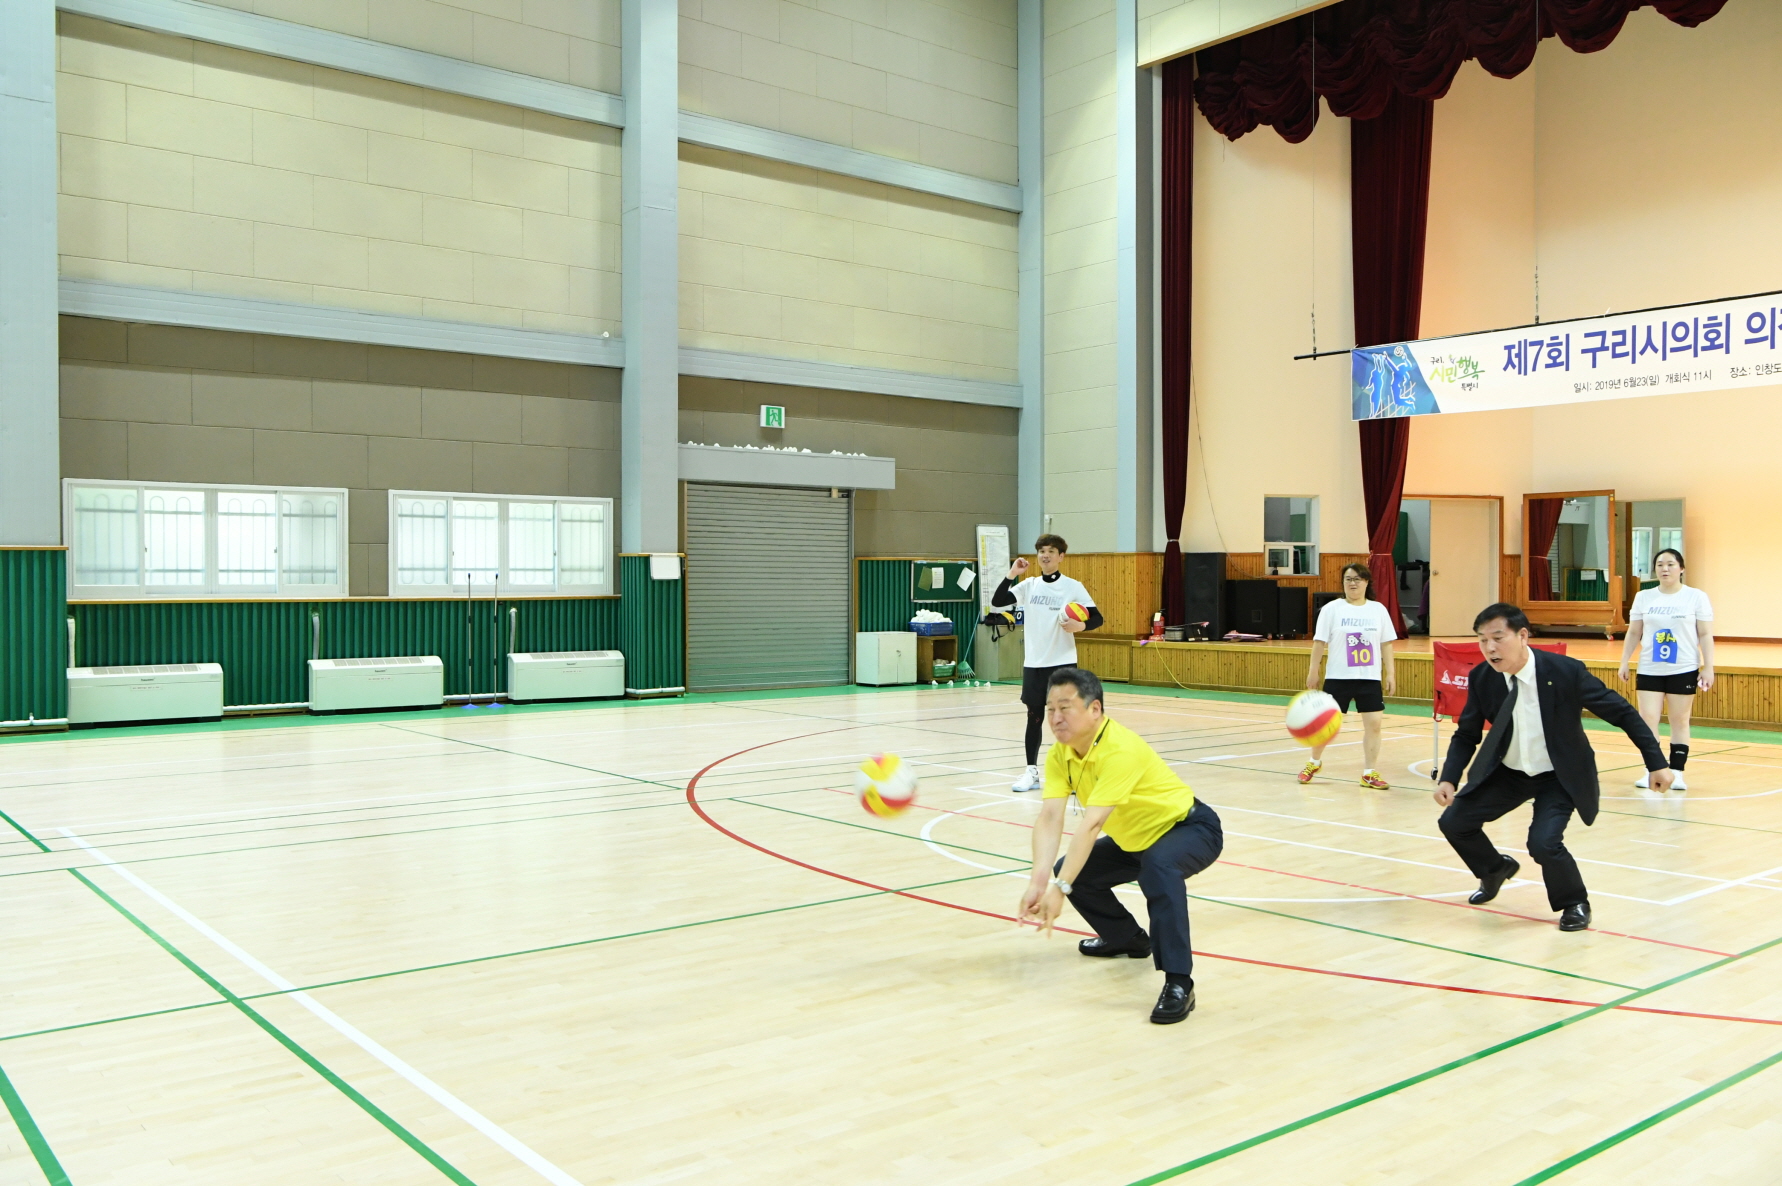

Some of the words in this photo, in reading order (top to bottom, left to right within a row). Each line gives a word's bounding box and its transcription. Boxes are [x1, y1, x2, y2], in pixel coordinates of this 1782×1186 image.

[1502, 333, 1570, 376] 제7회
[1581, 313, 1731, 369] 구리시의회
[1744, 307, 1782, 350] 의
[1573, 381, 1592, 393] 일시:
[1595, 378, 1621, 390] 2019년
[1623, 374, 1660, 388] 6월23(일)
[1665, 371, 1691, 384] 개회식
[1694, 369, 1712, 381] 11시
[1730, 366, 1751, 379] 장소:
[1755, 363, 1782, 376] 인창도
[1351, 648, 1371, 664] 10
[1659, 645, 1671, 660] 9
